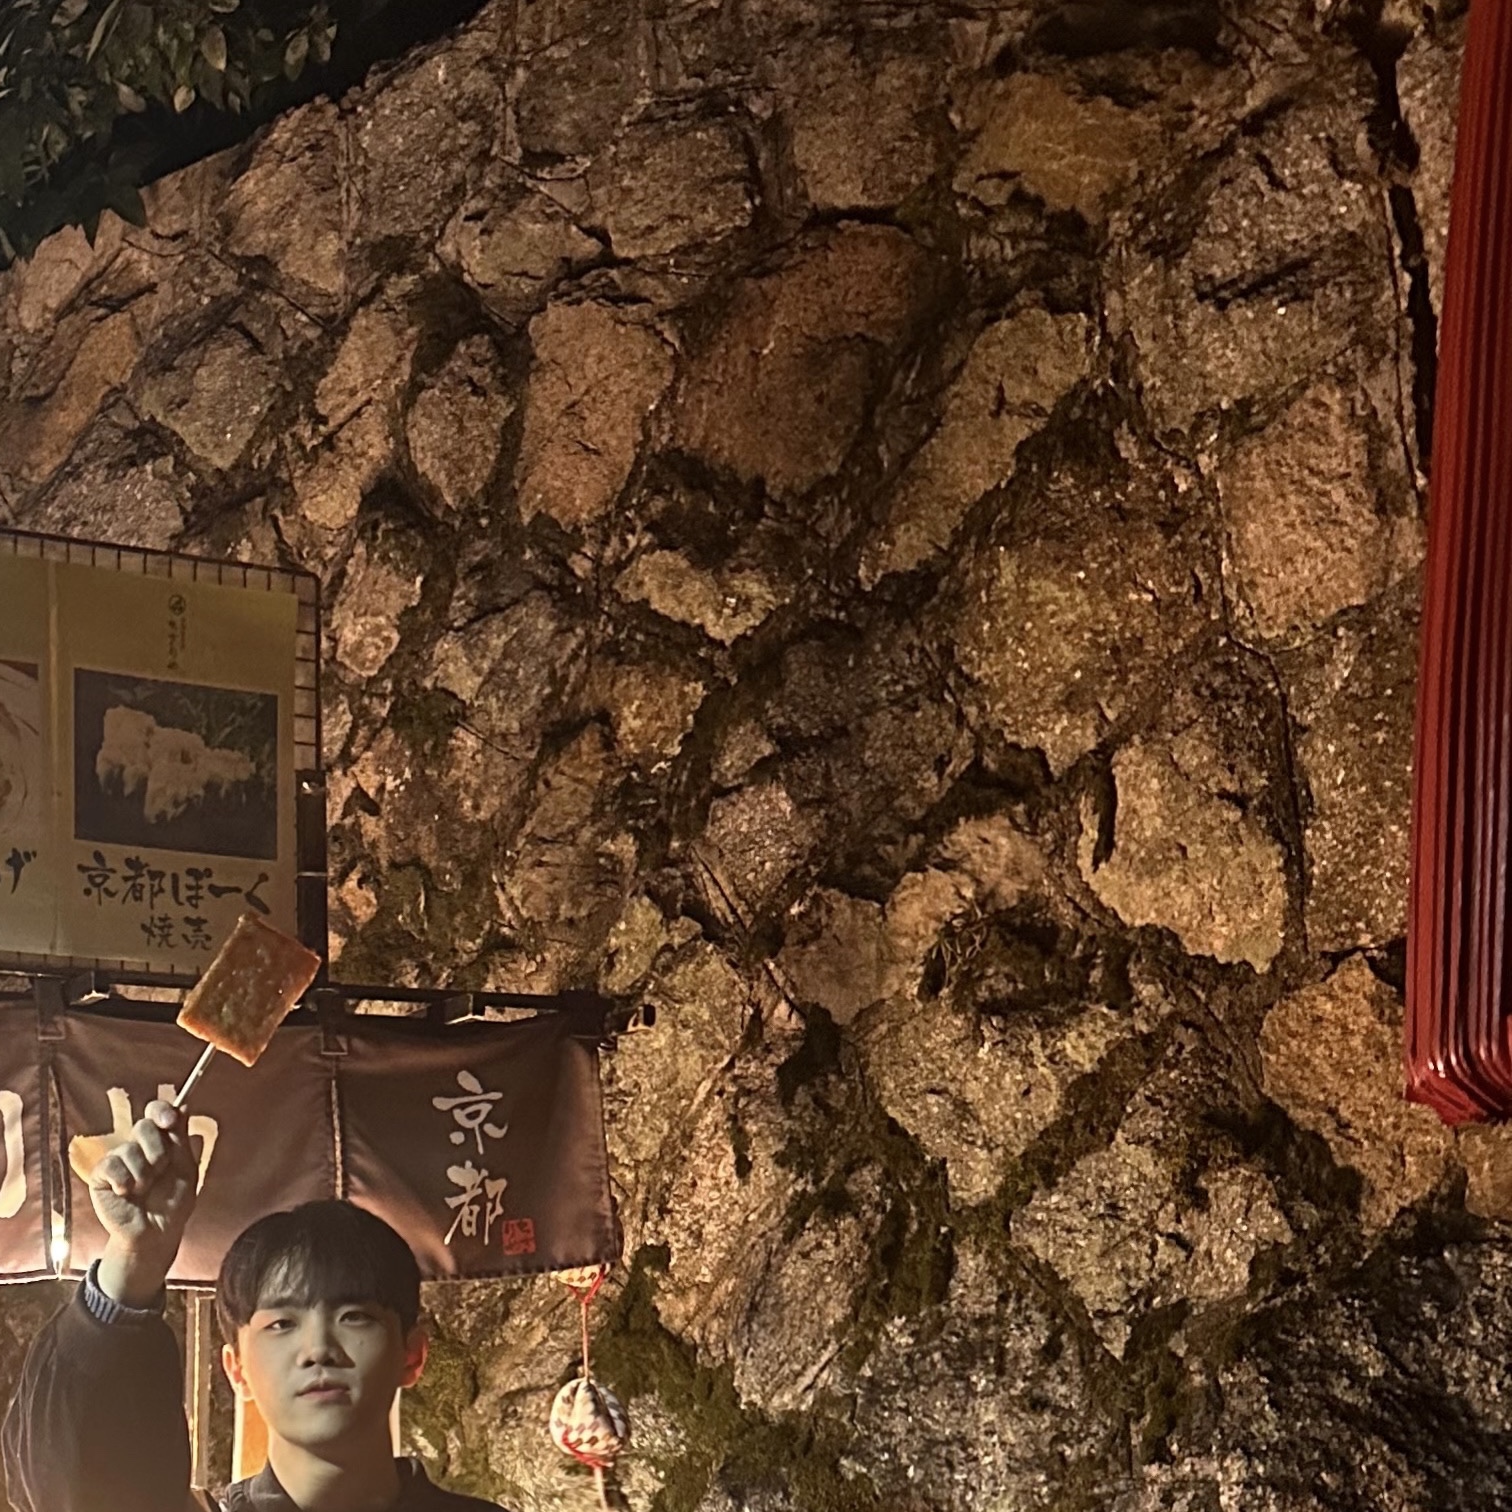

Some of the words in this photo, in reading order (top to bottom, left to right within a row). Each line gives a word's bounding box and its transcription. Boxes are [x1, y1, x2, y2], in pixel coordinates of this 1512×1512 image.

[77, 850, 272, 916] 京都ぽーく
[142, 916, 213, 951] 焼売
[432, 1070, 508, 1245] 京都
